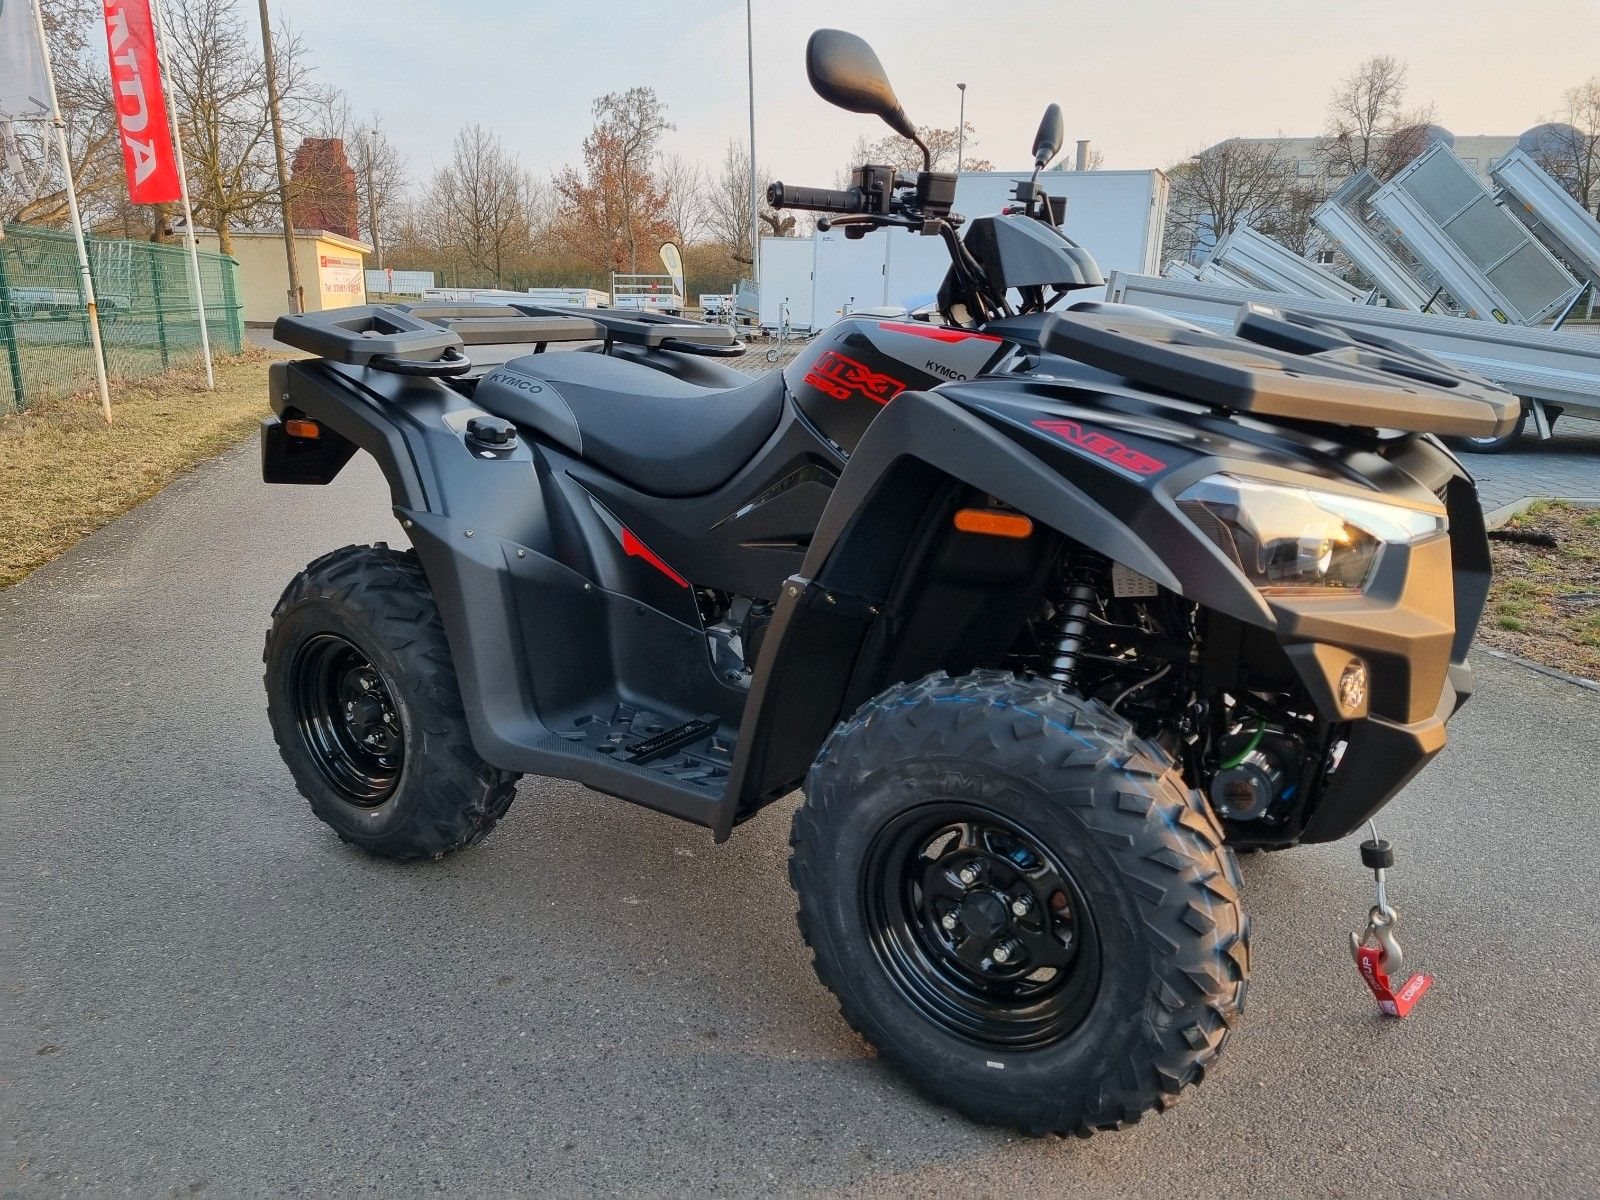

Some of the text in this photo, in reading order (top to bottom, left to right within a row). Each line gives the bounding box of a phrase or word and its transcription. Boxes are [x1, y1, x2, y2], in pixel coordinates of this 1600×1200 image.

[105, 0, 157, 186] NDA
[489, 373, 543, 394] KYMCO
[925, 359, 967, 381] KYMCO
[1030, 419, 1168, 475] ABS
